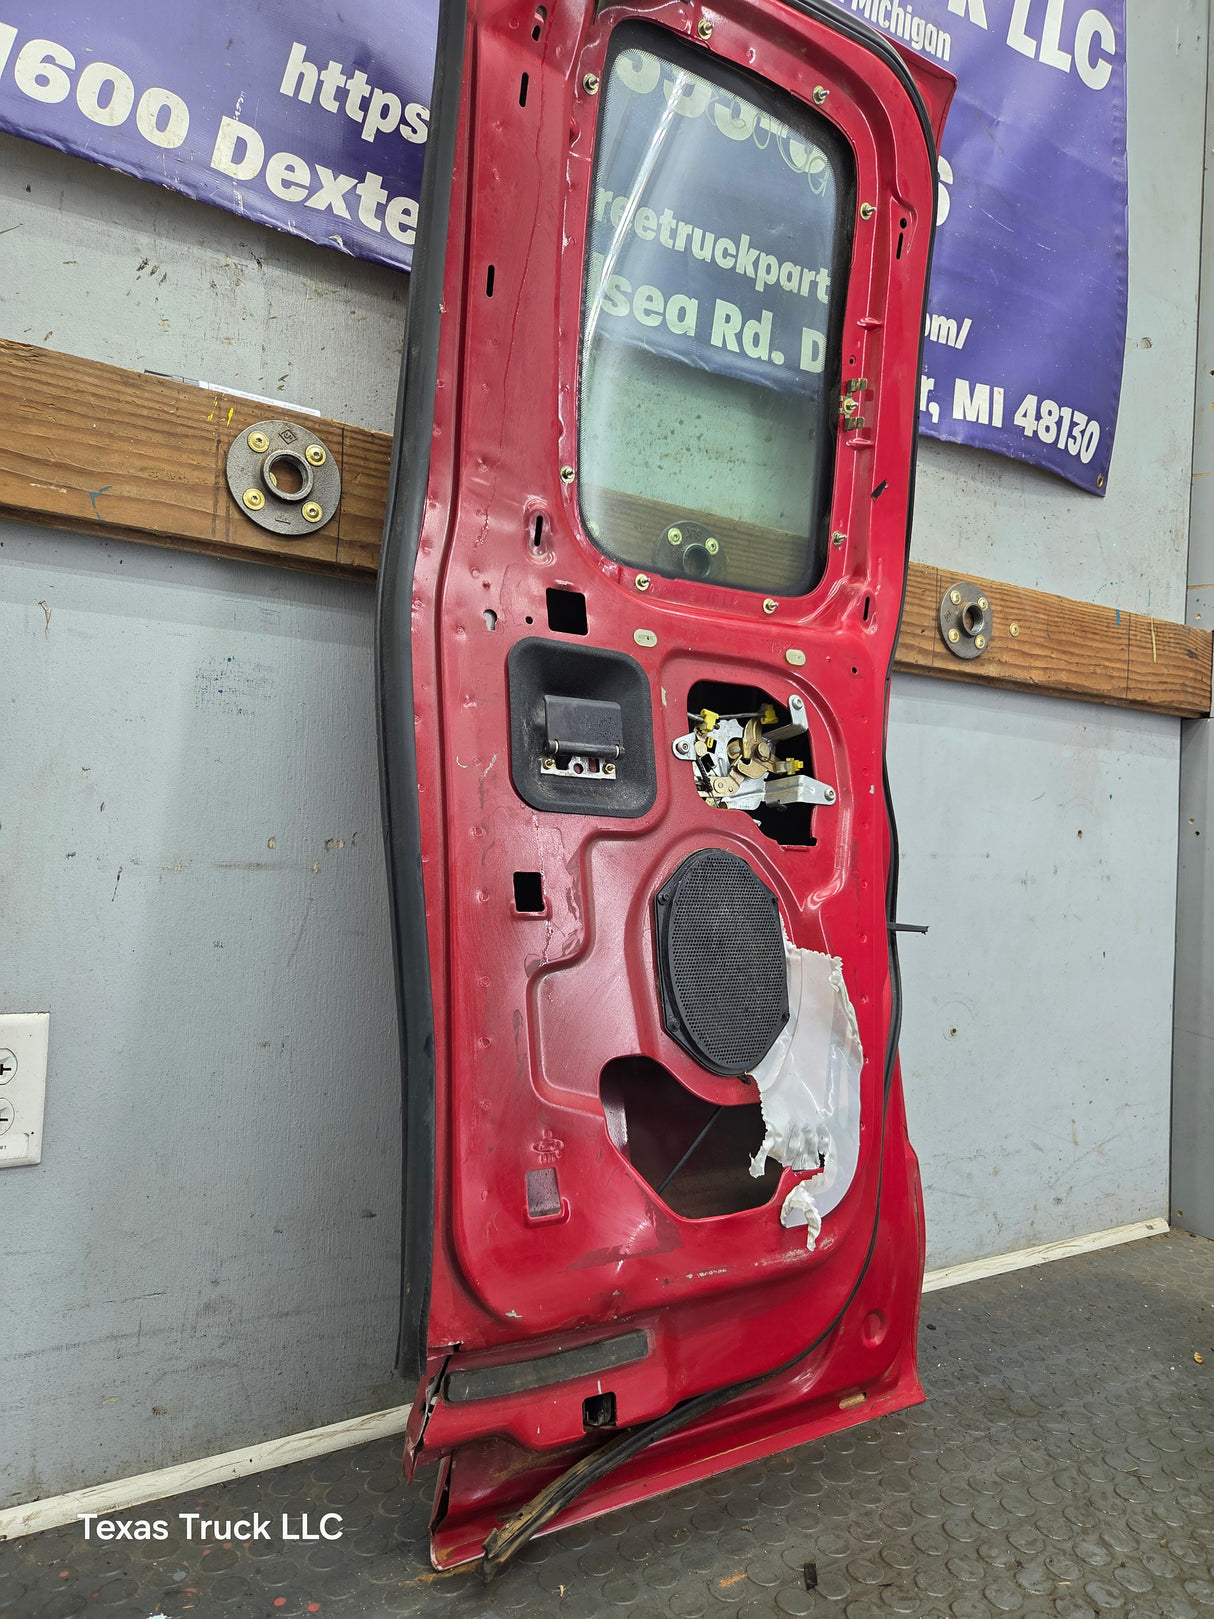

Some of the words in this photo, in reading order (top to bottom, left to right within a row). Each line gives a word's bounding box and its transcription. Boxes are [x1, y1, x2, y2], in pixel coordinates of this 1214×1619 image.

[280, 42, 430, 144] https
[1006, 0, 1115, 90] LLC
[210, 116, 421, 245] Dexte
[711, 299, 785, 365] Rd.
[952, 378, 1004, 428] MI
[1014, 394, 1101, 464] 48130
